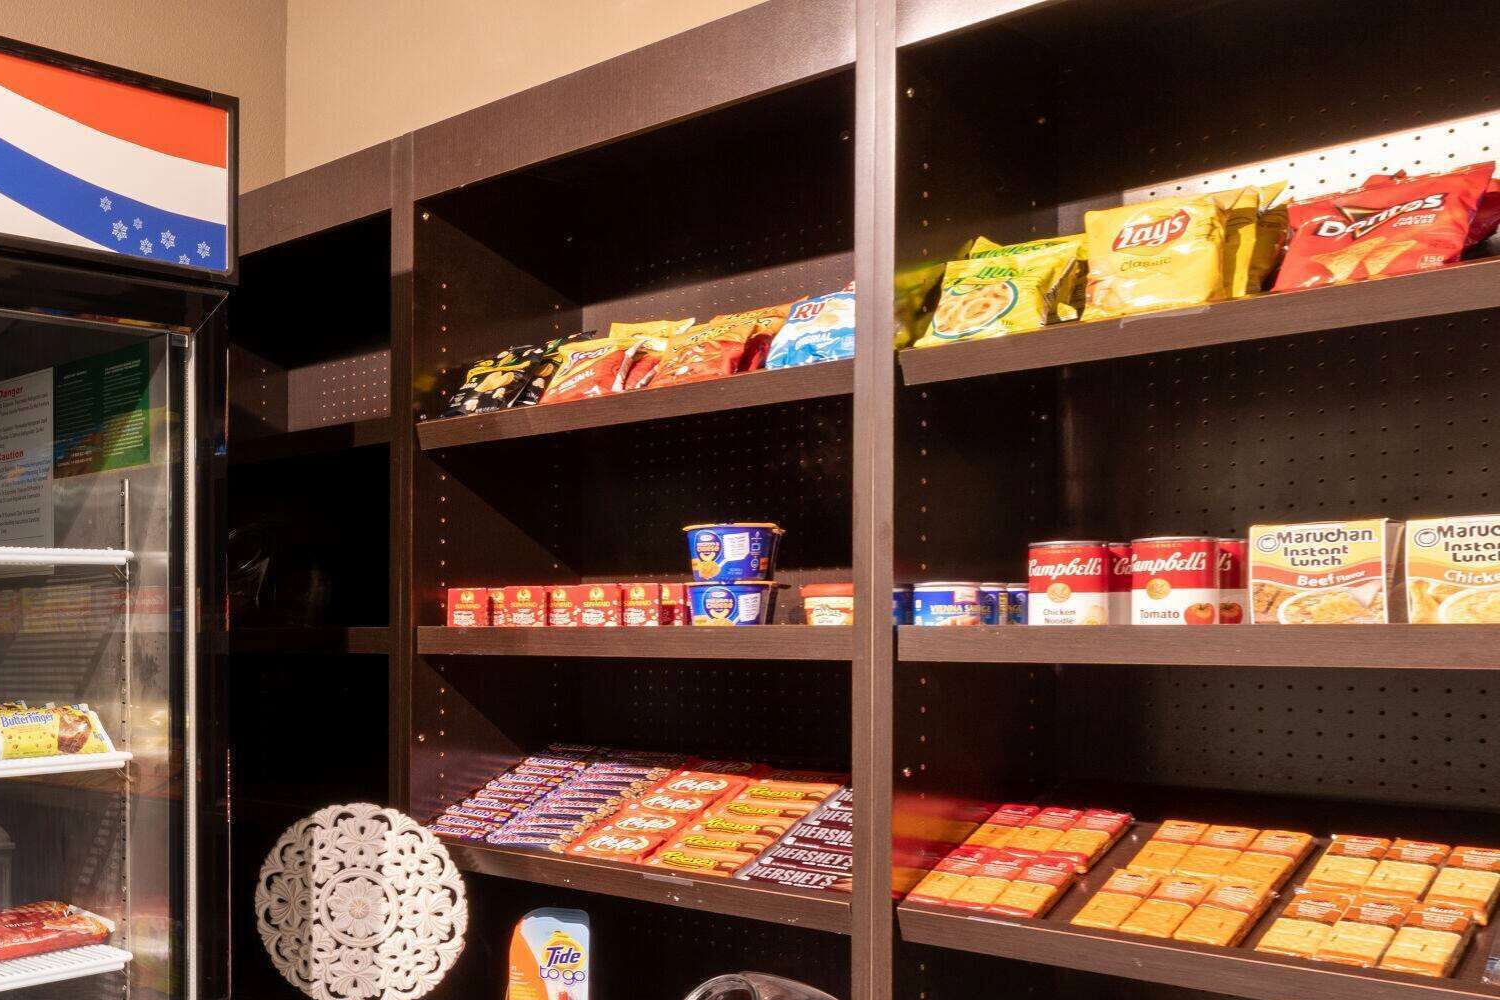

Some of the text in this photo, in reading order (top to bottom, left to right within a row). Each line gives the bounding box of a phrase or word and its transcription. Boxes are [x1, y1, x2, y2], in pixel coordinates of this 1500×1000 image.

[1316, 193, 1447, 238] Doritos
[1120, 256, 1172, 272] Classic
[1277, 528, 1373, 545] Maruchan
[1437, 524, 1500, 539] Maruc
[1283, 545, 1349, 557] Instant
[1290, 556, 1342, 567] Lunch
[1296, 572, 1335, 587] Beef
[930, 604, 963, 614] VIENNA
[1043, 608, 1077, 616] Chicken
[1139, 609, 1180, 619] Tomato
[1, 712, 54, 728] Butterfinger
[748, 865, 838, 888] HERSHEY'S
[546, 946, 581, 968] Tide
[539, 965, 586, 986] to go
